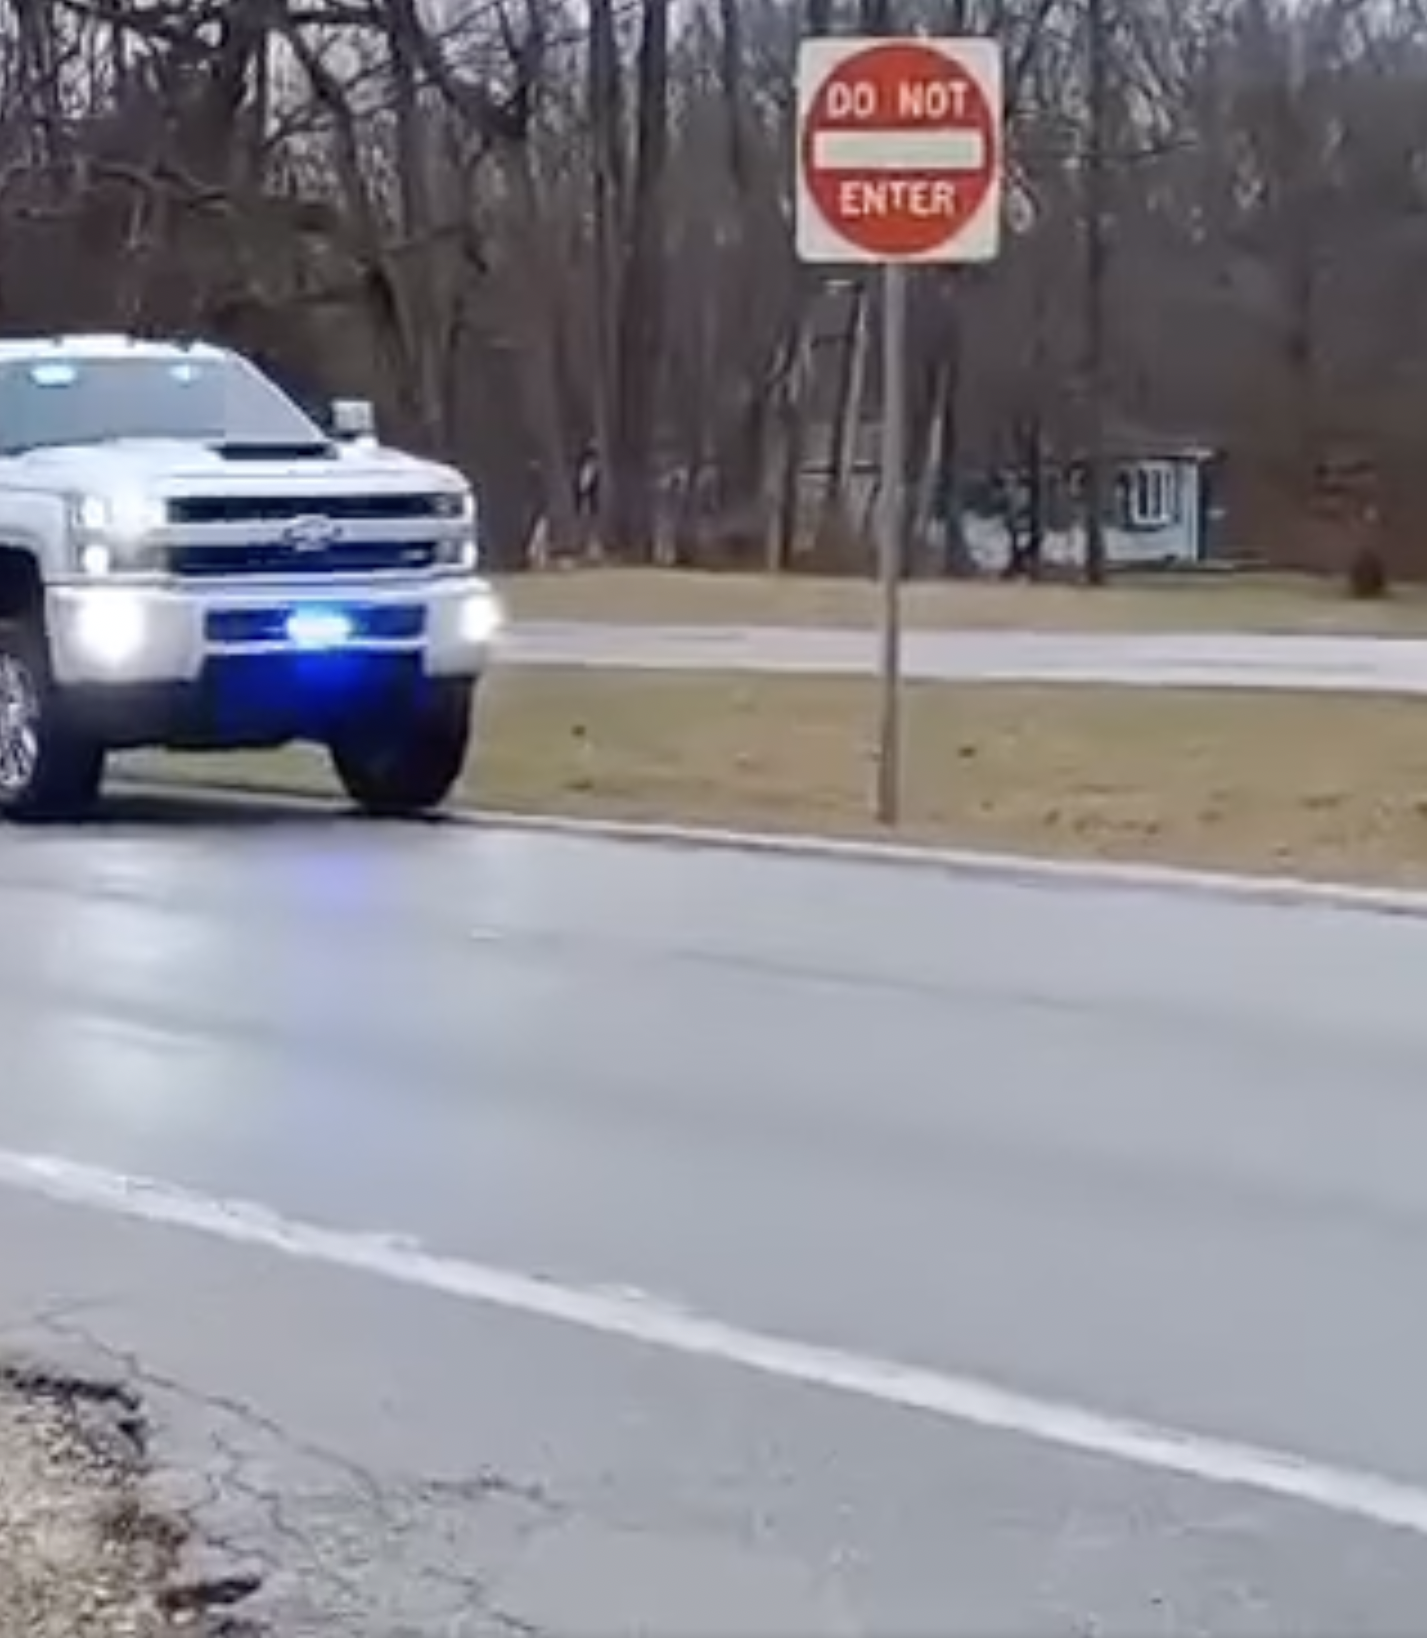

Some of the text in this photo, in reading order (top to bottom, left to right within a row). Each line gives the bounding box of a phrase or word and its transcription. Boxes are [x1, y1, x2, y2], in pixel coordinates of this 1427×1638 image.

[827, 81, 968, 118] DO NOT
[840, 180, 955, 217] ENTER
